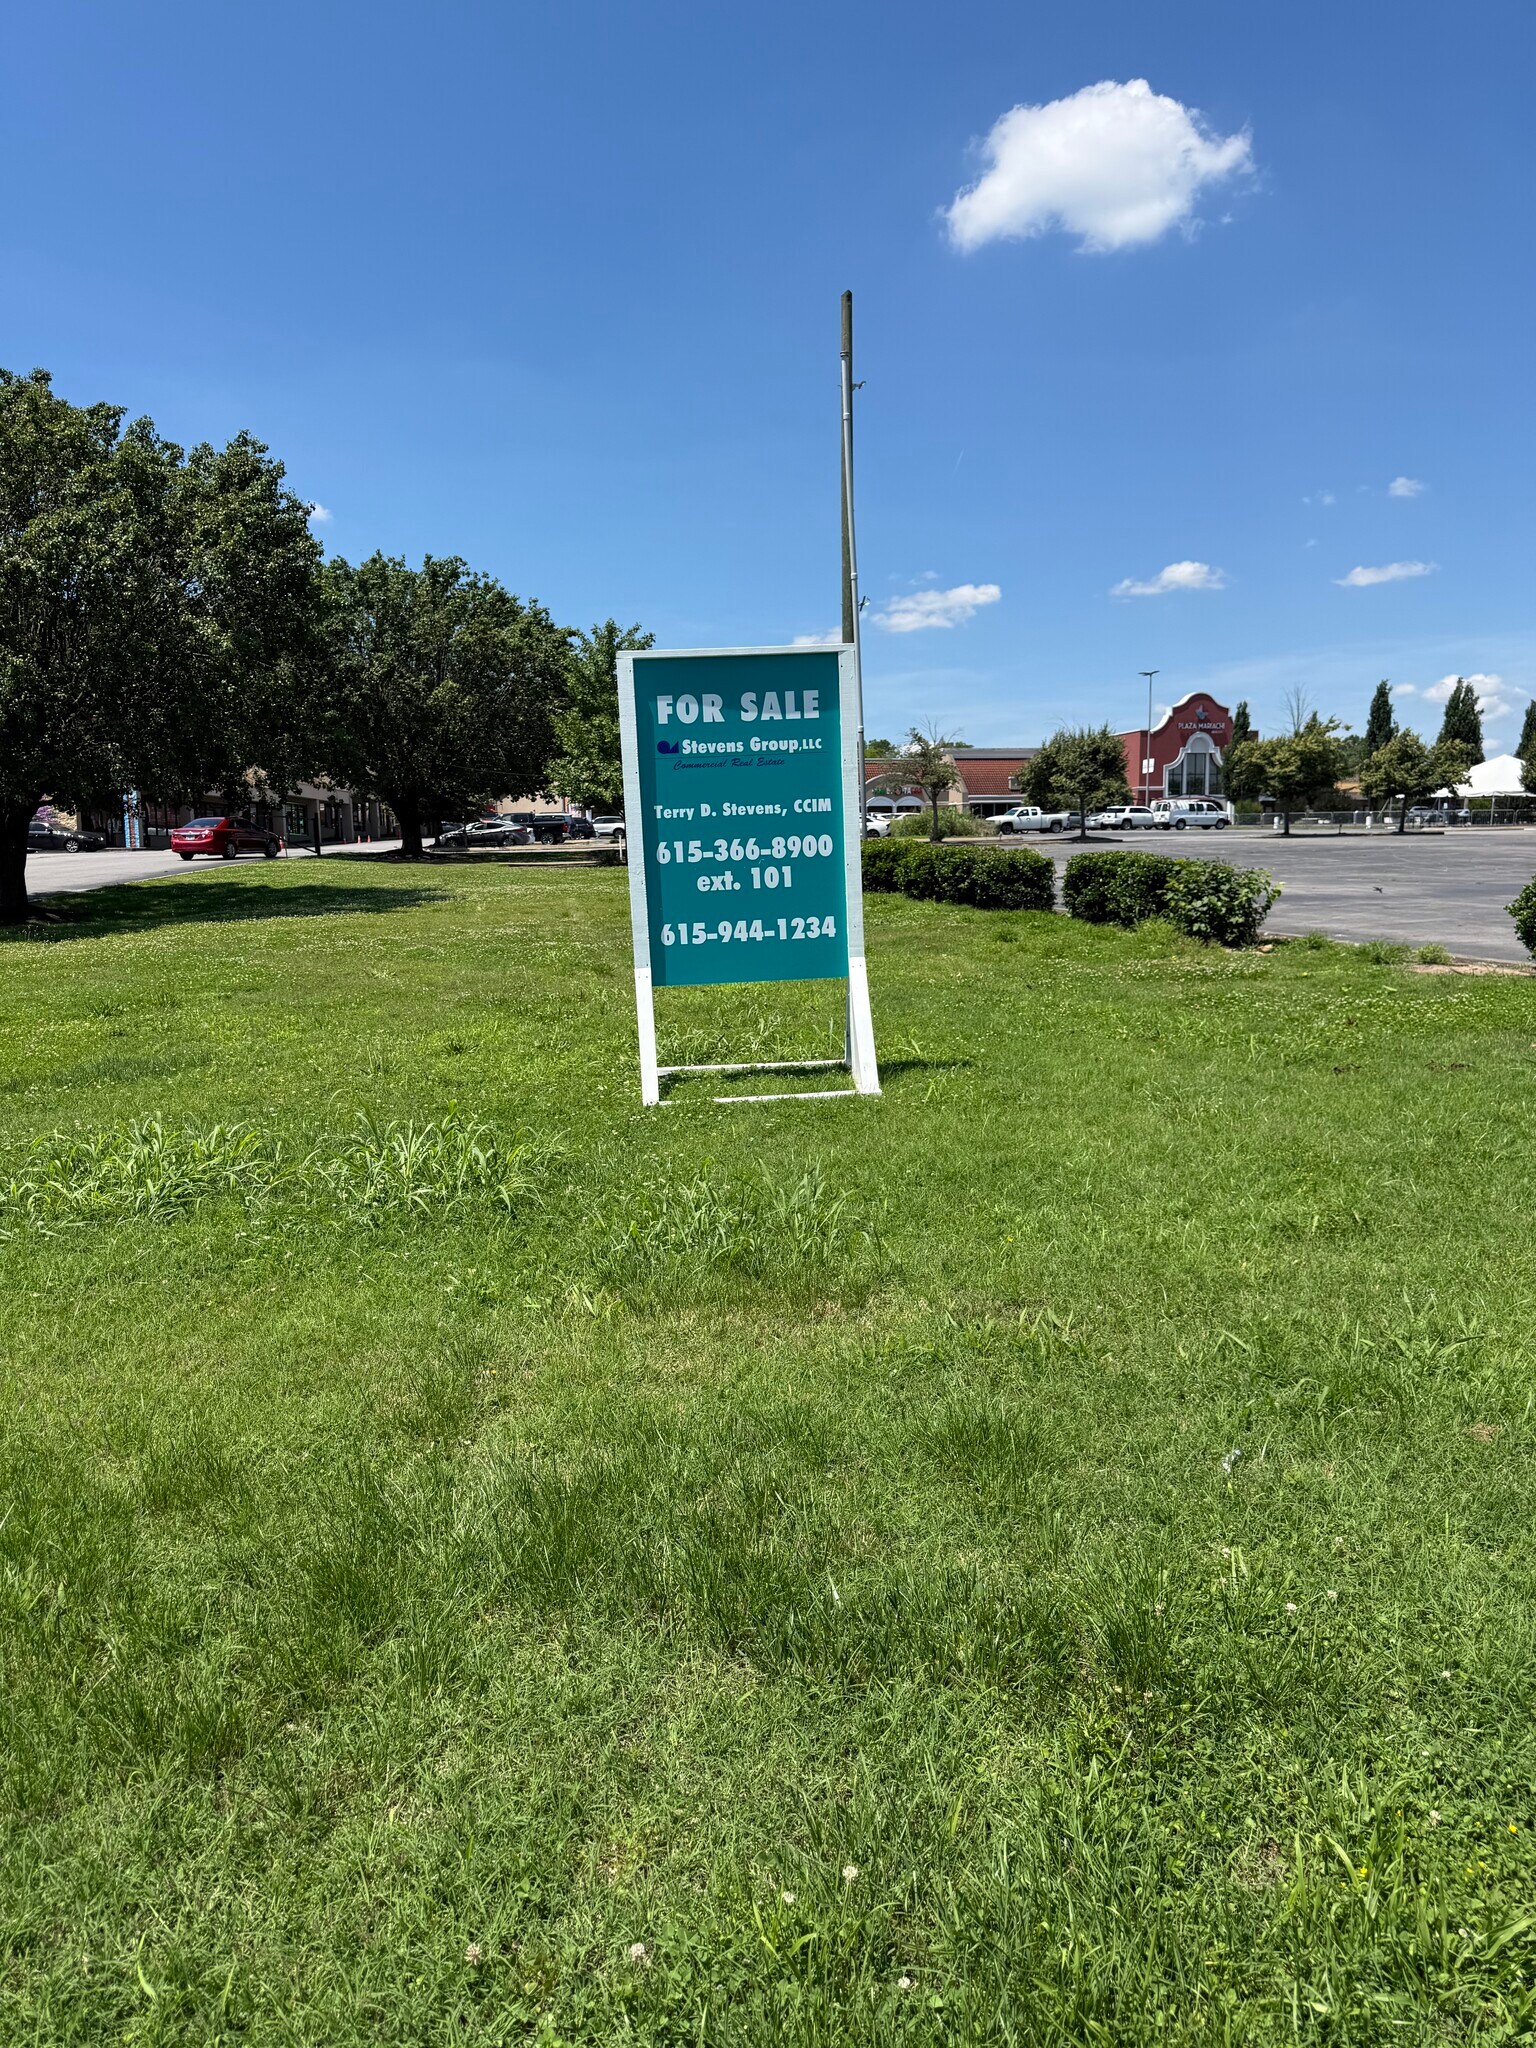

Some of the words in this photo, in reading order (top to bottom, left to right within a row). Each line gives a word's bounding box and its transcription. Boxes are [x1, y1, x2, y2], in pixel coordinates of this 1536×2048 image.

[656, 693, 725, 725] FOR
[740, 690, 820, 722] SALE
[682, 739, 744, 754] Stevens
[673, 759, 727, 771] Commercial
[731, 757, 753, 768] Real
[756, 756, 785, 767] Estate
[654, 805, 695, 820] Terry
[700, 803, 717, 817] D.
[722, 802, 788, 817] Stevens,
[793, 798, 832, 813] CCIM
[656, 834, 833, 864] 615-366-8900
[697, 870, 741, 892] ext.
[751, 865, 792, 889] 101
[660, 916, 836, 946] 615-944-1234
